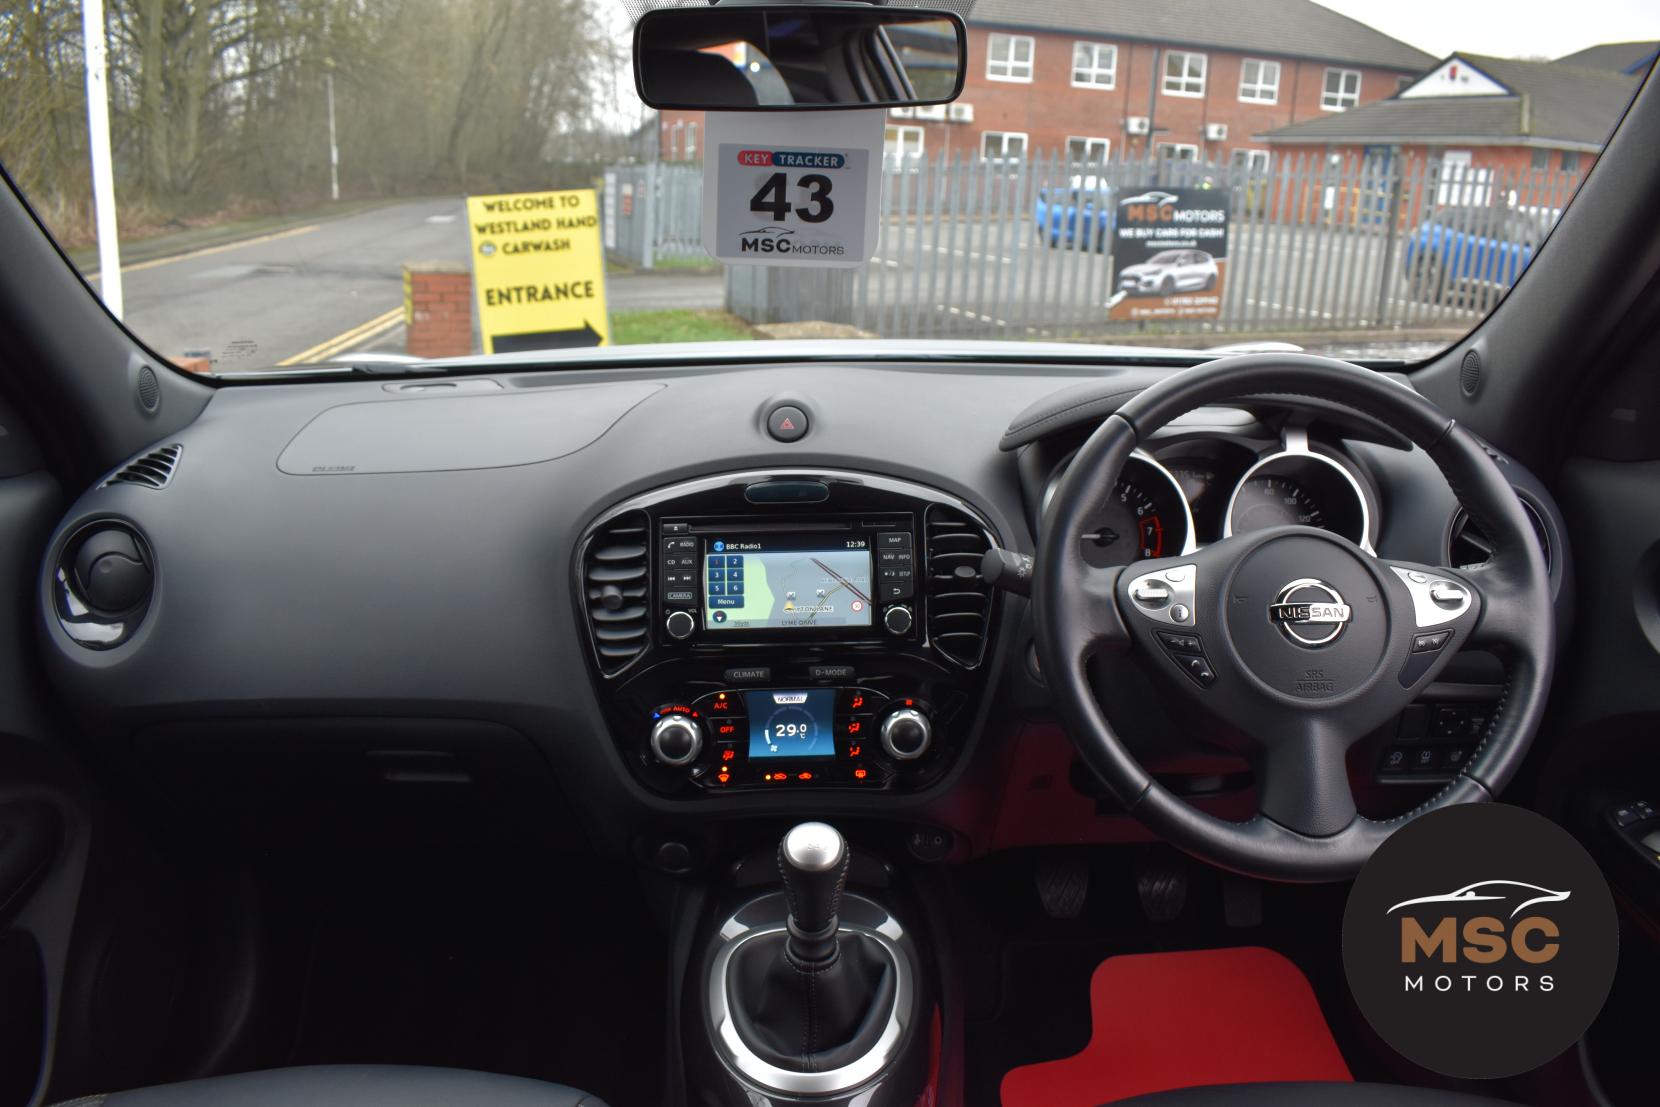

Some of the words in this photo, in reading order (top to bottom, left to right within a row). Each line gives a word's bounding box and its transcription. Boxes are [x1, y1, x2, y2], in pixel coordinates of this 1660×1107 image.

[744, 153, 769, 163] KEY
[779, 154, 838, 167] TRACKER
[483, 196, 554, 212] WELCOME
[559, 195, 580, 208] TO
[750, 172, 834, 224] 43
[1127, 204, 1174, 221] MSC
[1173, 210, 1225, 223] MOTORS
[475, 218, 552, 235] WESTLAND
[557, 215, 598, 228] HAND
[1119, 228, 1133, 238] WE
[1136, 228, 1153, 238] BUY
[1155, 228, 1178, 238] CARS
[1180, 228, 1197, 238] FOR
[502, 238, 571, 255] CARWASH
[741, 237, 791, 253] MSC
[792, 244, 845, 255] MOTORS
[485, 280, 594, 306] ENTRANCE
[1120, 493, 1127, 502] 5
[1284, 497, 1297, 505] 100
[1137, 507, 1144, 515] 6
[1278, 605, 1345, 620] NISSAN
[733, 670, 765, 678] CLIMATE
[1304, 669, 1324, 680] SRS
[1296, 682, 1334, 692] AIRBAG
[673, 705, 691, 713] AUTO
[719, 726, 735, 734] OFF
